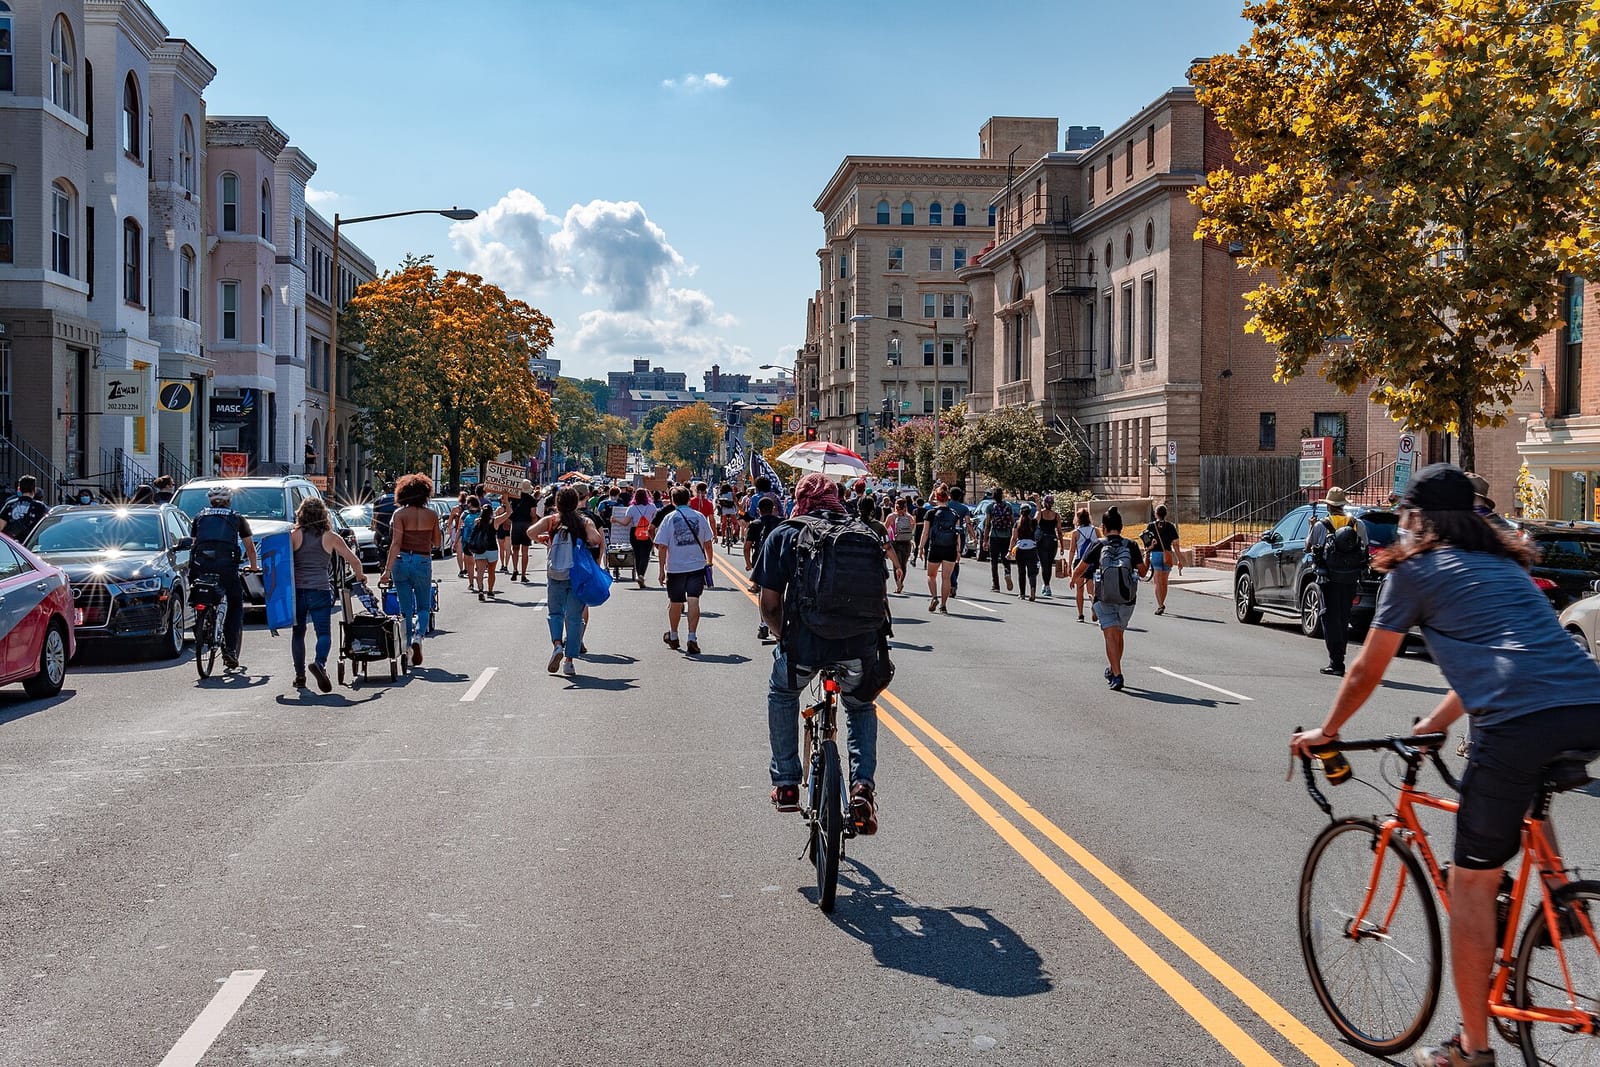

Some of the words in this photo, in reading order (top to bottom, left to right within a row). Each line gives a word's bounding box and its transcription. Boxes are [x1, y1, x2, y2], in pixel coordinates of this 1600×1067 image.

[216, 404, 241, 413] MASC
[490, 464, 526, 478] SILENCE
[485, 475, 521, 488] CONSENT
